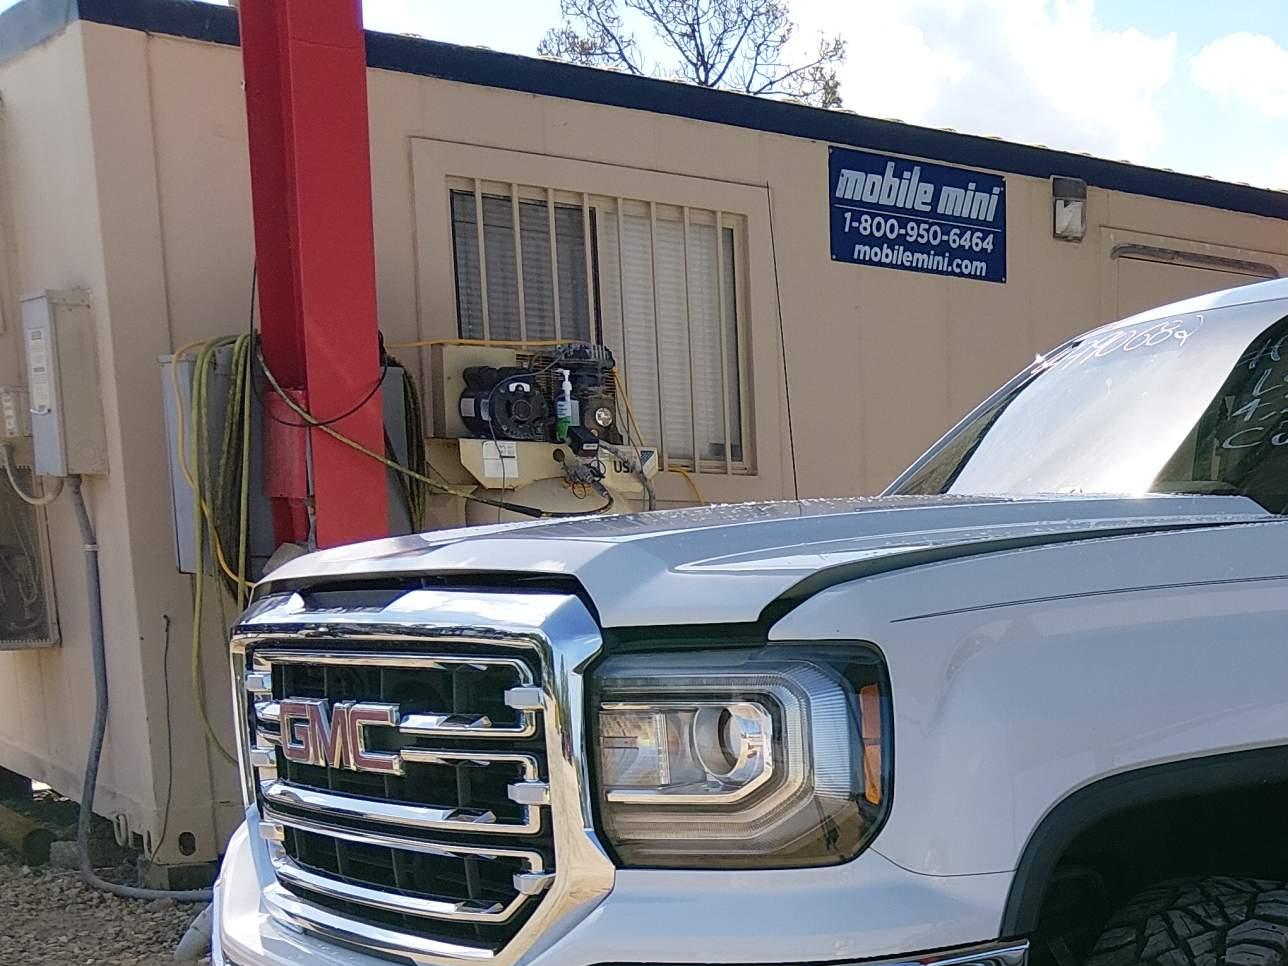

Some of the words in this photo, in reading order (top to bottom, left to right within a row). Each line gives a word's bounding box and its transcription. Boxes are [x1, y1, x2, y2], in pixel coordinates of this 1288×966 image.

[835, 161, 935, 212] mobile
[937, 182, 1000, 222] mini
[843, 211, 994, 253] 1-800-950-6464
[853, 243, 987, 276] mobilemini.com
[280, 697, 403, 776] GMC
